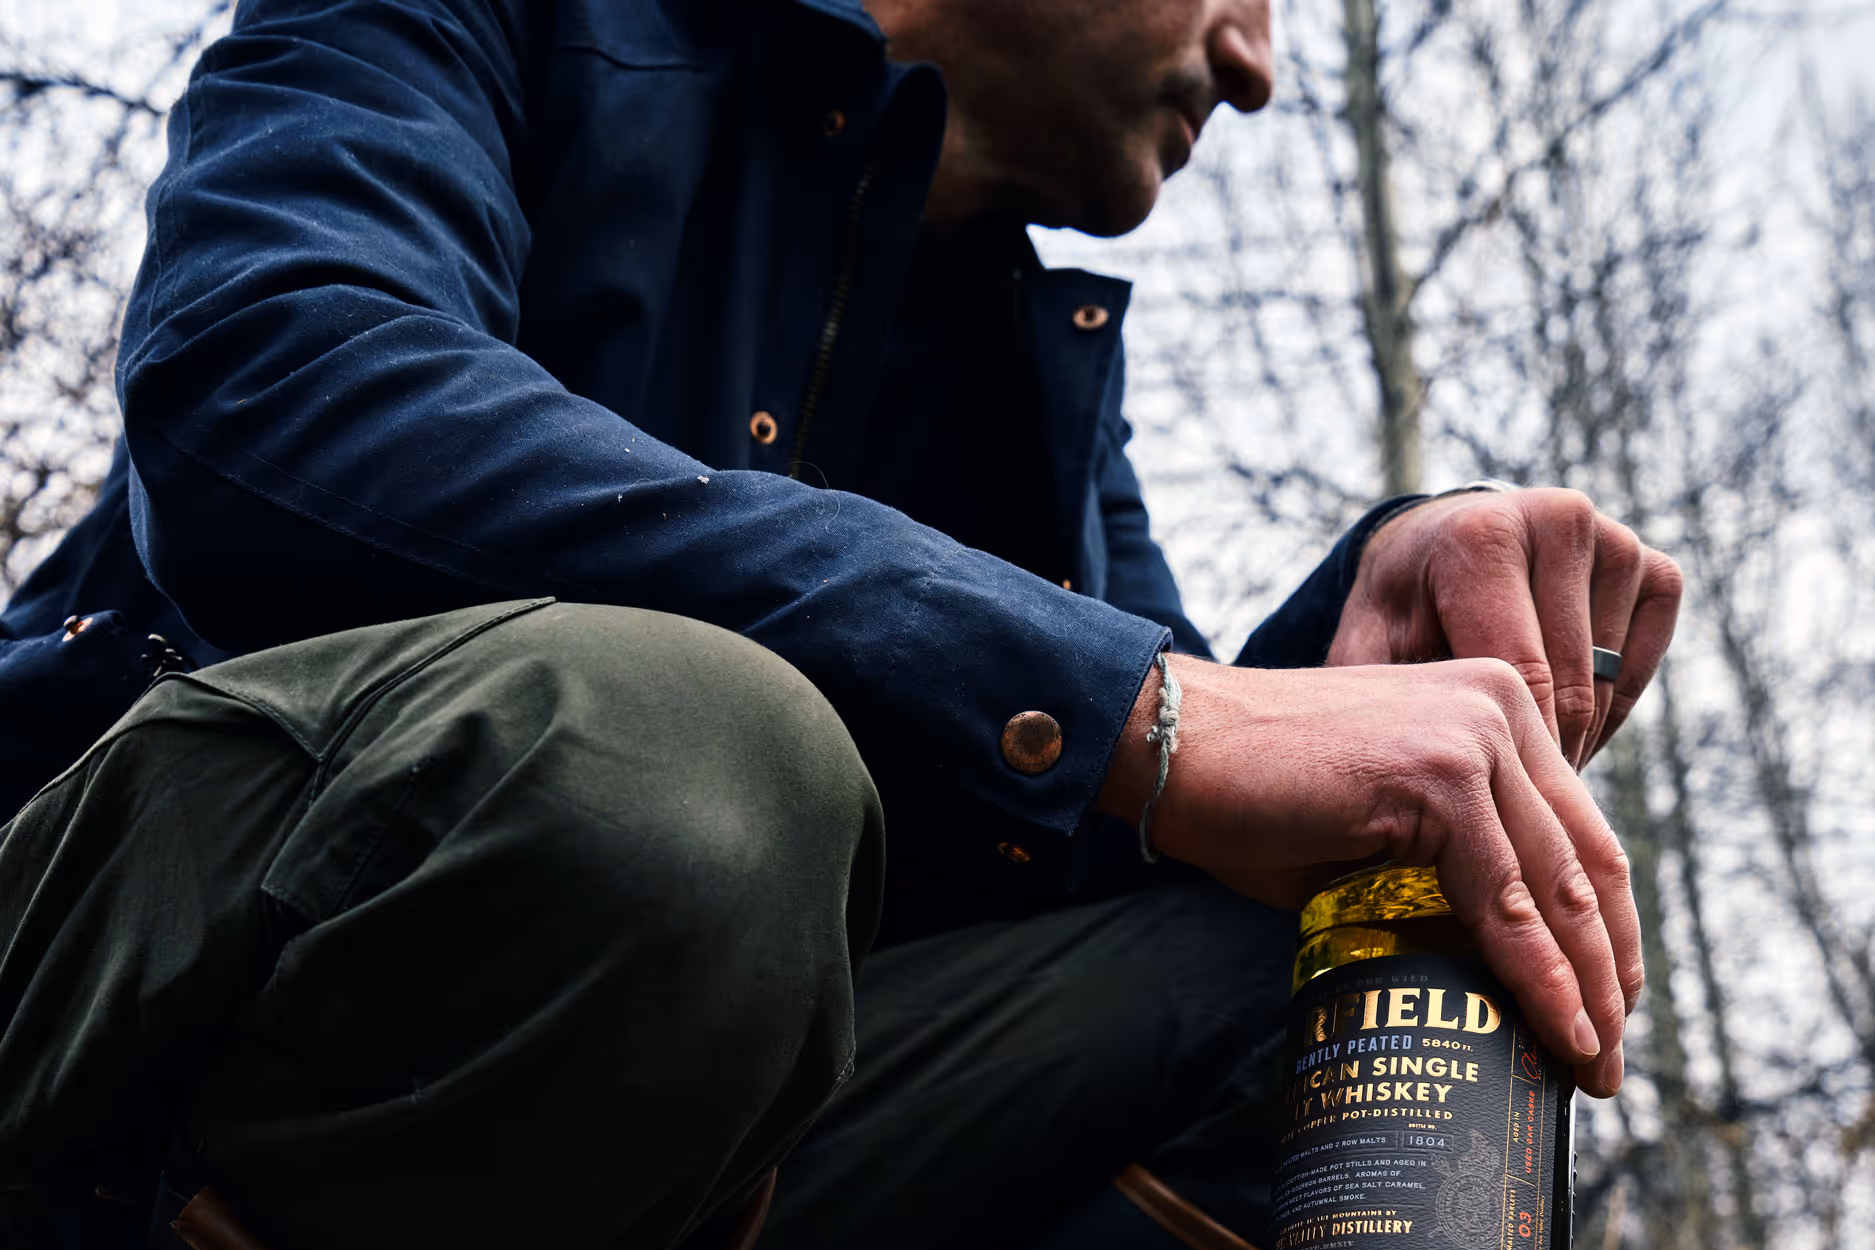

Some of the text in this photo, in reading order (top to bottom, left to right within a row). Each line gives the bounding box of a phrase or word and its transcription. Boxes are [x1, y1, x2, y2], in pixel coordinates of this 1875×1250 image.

[1347, 1034, 1413, 1055] PEATED
[1421, 1037, 1461, 1050] 5840
[1371, 1056, 1479, 1082] SINGLE
[1320, 1081, 1454, 1110] WHISKEY
[1342, 1109, 1454, 1121] POT-DISTILLED
[1514, 1111, 1521, 1120] IN
[1525, 1090, 1536, 1173] USED OAK CASKS
[1319, 1142, 1334, 1151] AND
[1341, 1139, 1358, 1147] ROW
[1359, 1136, 1387, 1145] MALTS
[1408, 1135, 1446, 1148] 1804
[1329, 1162, 1344, 1171] POT
[1345, 1159, 1373, 1168] STILLS
[1355, 1170, 1388, 1178] AROMAS
[1303, 1186, 1332, 1199] FLAVORS
[1333, 1184, 1344, 1192] OF
[1362, 1181, 1383, 1189] SALT
[1303, 1196, 1337, 1209] AUTUMNAL
[1339, 1193, 1367, 1202] SMOKE.
[1332, 1210, 1383, 1219] MOUNTAINS
[1331, 1219, 1414, 1236] DISTILLERY
[1518, 1211, 1532, 1238] 03
